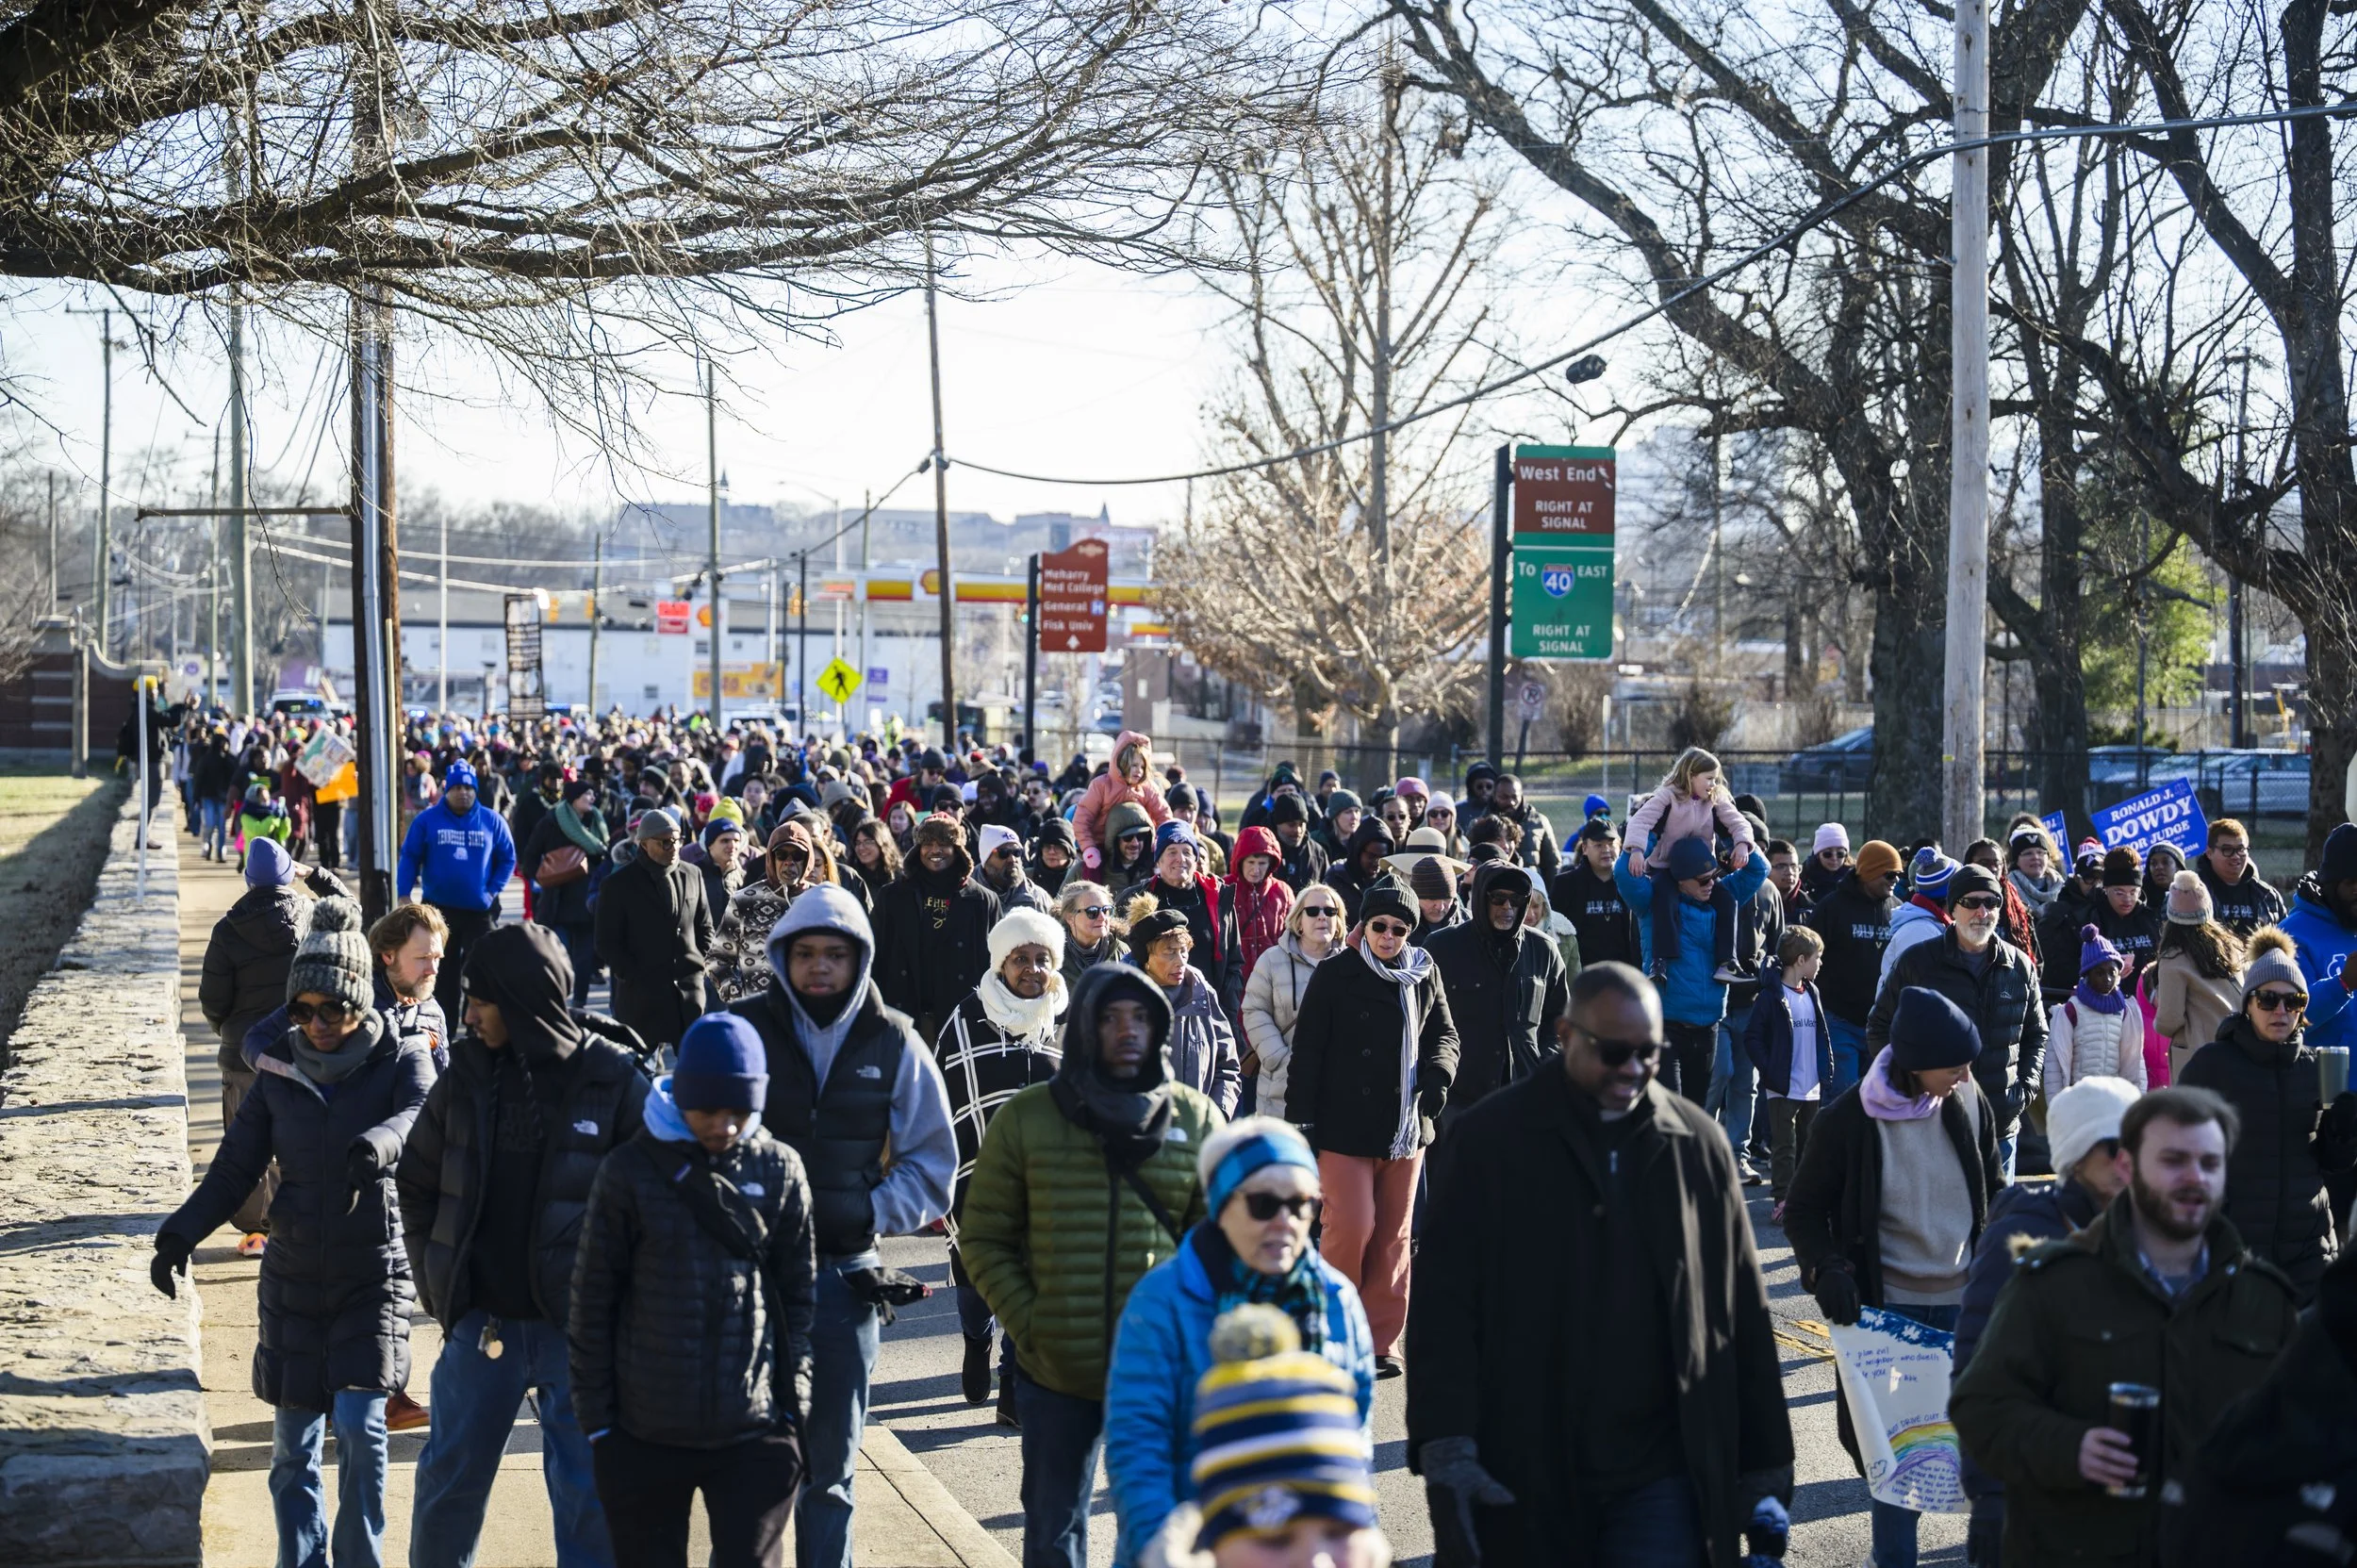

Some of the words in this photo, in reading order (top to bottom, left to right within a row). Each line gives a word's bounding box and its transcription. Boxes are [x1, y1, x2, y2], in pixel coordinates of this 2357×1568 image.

[1520, 466, 1559, 481] West
[1567, 467, 1596, 482] End
[1535, 500, 1573, 513] RIGHT
[1577, 501, 1594, 513] AT
[1541, 517, 1587, 530] SIGNAL
[1044, 569, 1091, 581] Meharry
[1577, 566, 1607, 578] EAST
[1545, 572, 1571, 591] 40
[1044, 582, 1064, 593] Med
[1067, 583, 1105, 595] College
[1044, 601, 1087, 612] General
[1043, 619, 1064, 631] Fisk
[1068, 620, 1095, 632] Univ
[1532, 623, 1571, 636] RIGHT
[1575, 625, 1591, 637] AT
[1539, 640, 1584, 653] SIGNAL
[2110, 794, 2161, 822] RONALD
[2163, 788, 2174, 801] J.
[2105, 795, 2192, 847] DOWDY
[2151, 819, 2190, 844] JUDGE
[437, 829, 465, 846] TENNESSEE
[469, 831, 485, 848] STATE
[1900, 1415, 1921, 1427] DRIVE
